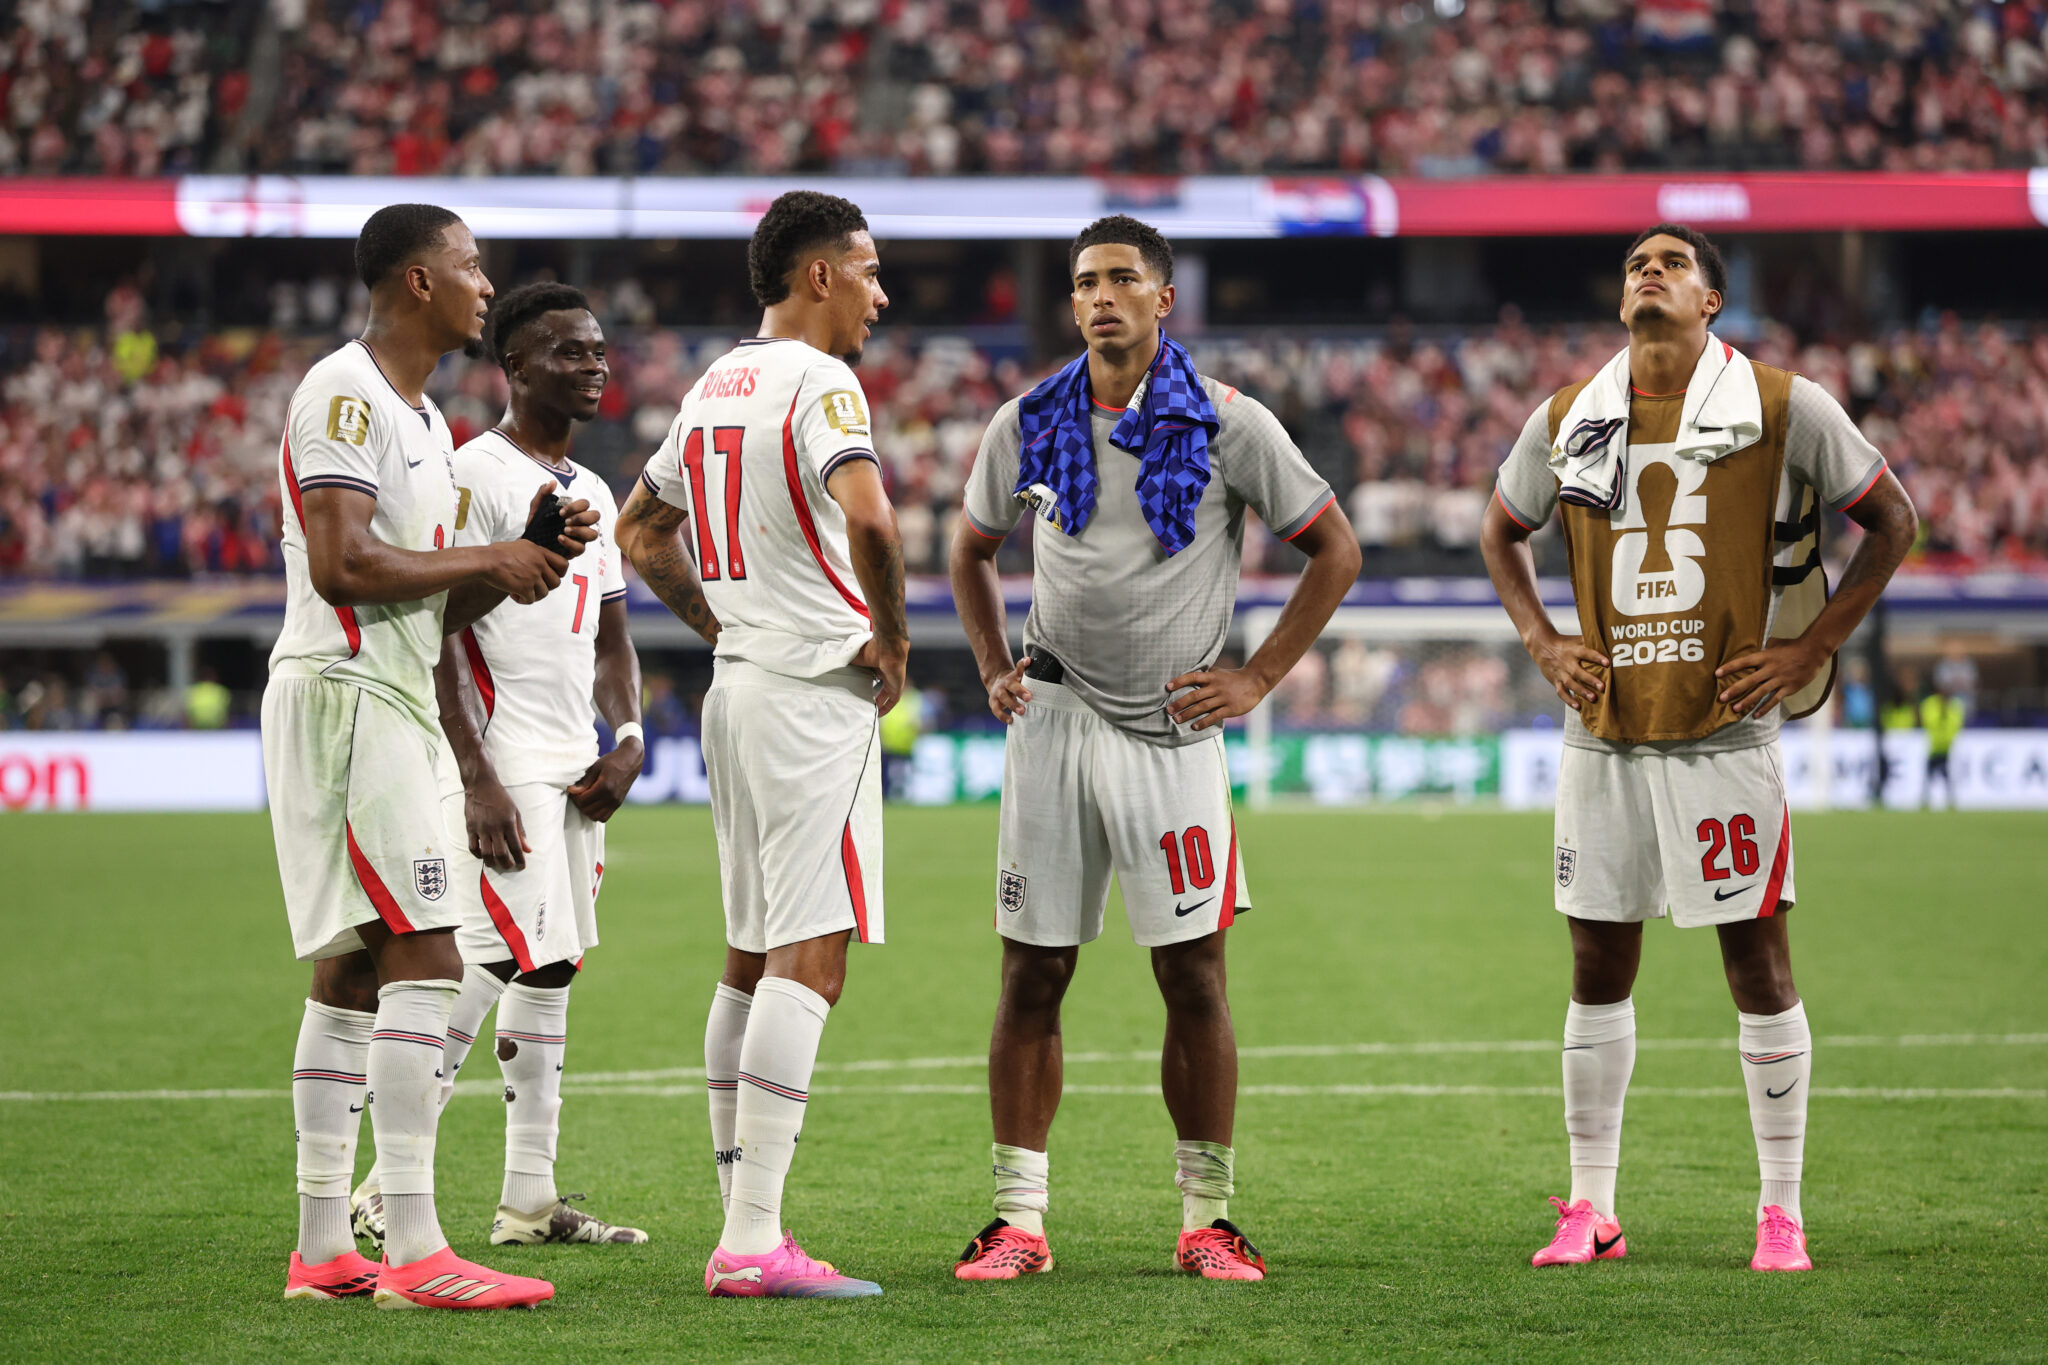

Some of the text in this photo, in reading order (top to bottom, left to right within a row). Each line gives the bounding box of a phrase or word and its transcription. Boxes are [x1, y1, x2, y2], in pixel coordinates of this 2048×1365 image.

[699, 367, 760, 401] ROGERS
[683, 426, 747, 581] 17
[571, 573, 588, 634] 7
[1636, 580, 1677, 600] FIFA
[1611, 619, 1705, 640] WORLD CUP
[1612, 638, 1705, 667] 2026
[1160, 825, 1215, 895] 10
[1696, 813, 1760, 882] 26
